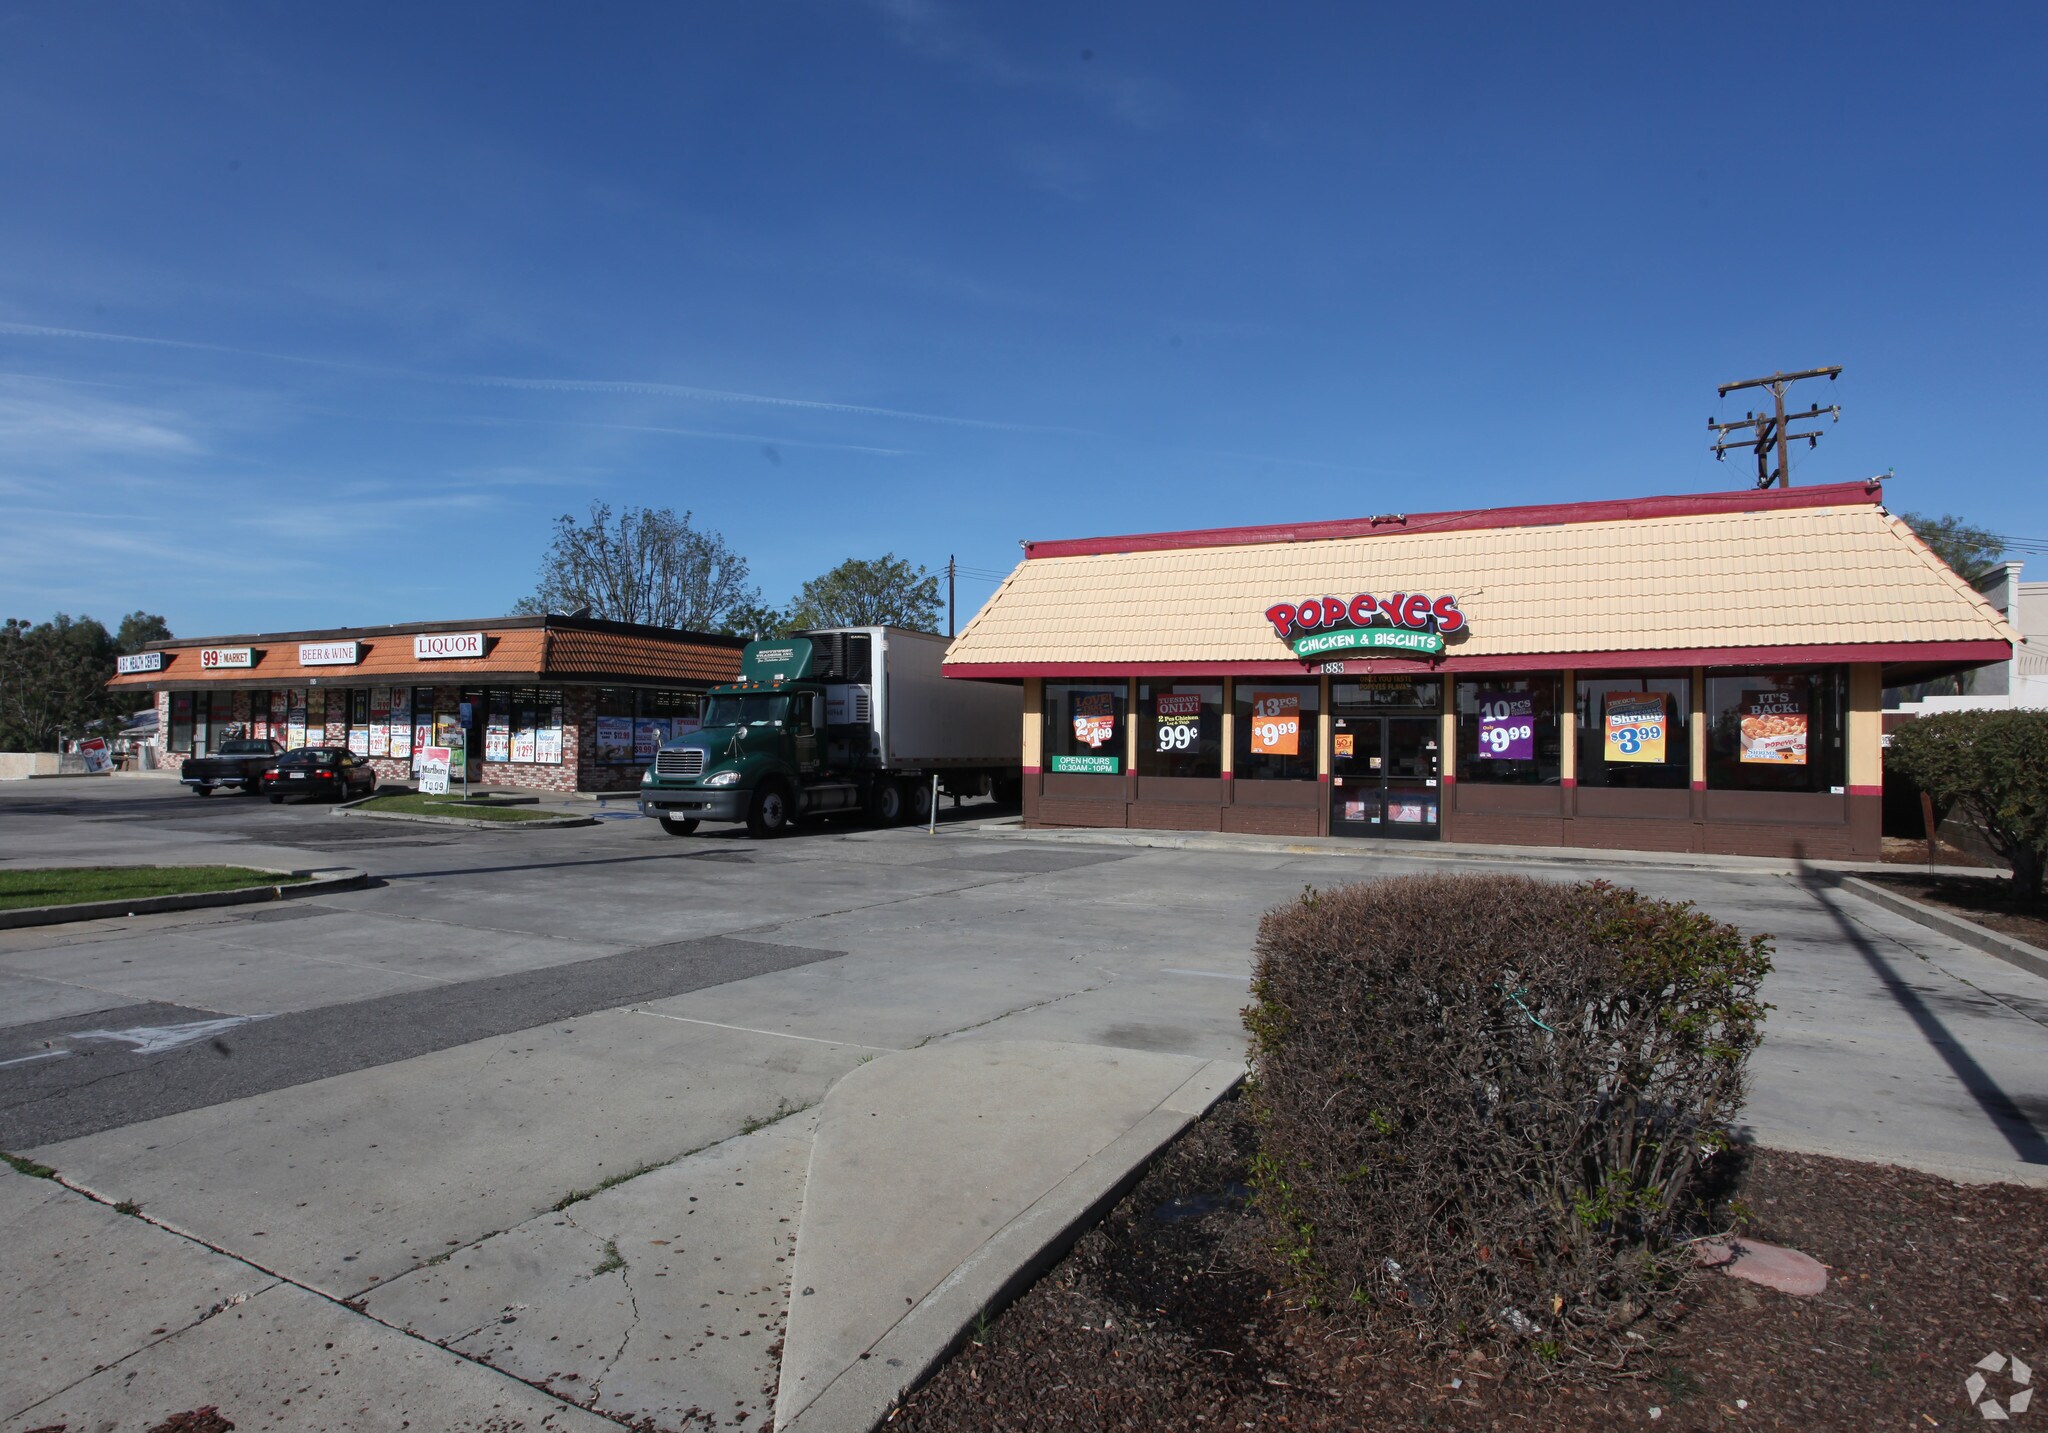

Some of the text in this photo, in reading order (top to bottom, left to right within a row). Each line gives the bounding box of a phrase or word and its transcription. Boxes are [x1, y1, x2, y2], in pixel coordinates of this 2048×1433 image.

[419, 636, 477, 655] LIQUOR
[1299, 633, 1436, 653] CHICKEN & BISCUITS
[203, 650, 218, 666] 99
[223, 652, 248, 663] MARKET
[302, 647, 354, 660] BEER & WINE
[1320, 662, 1345, 674] 1883
[1160, 695, 1199, 704] TUESDAYS
[1758, 693, 1789, 703] IT'S
[1160, 702, 1199, 714] ONLY!
[1255, 697, 1298, 718] 13 PCS
[1481, 699, 1531, 722] 10 PCS
[1750, 703, 1799, 714] BACK!
[1075, 718, 1089, 737] 2
[1159, 725, 1198, 750] 99¢
[422, 764, 447, 775] Marlboro
